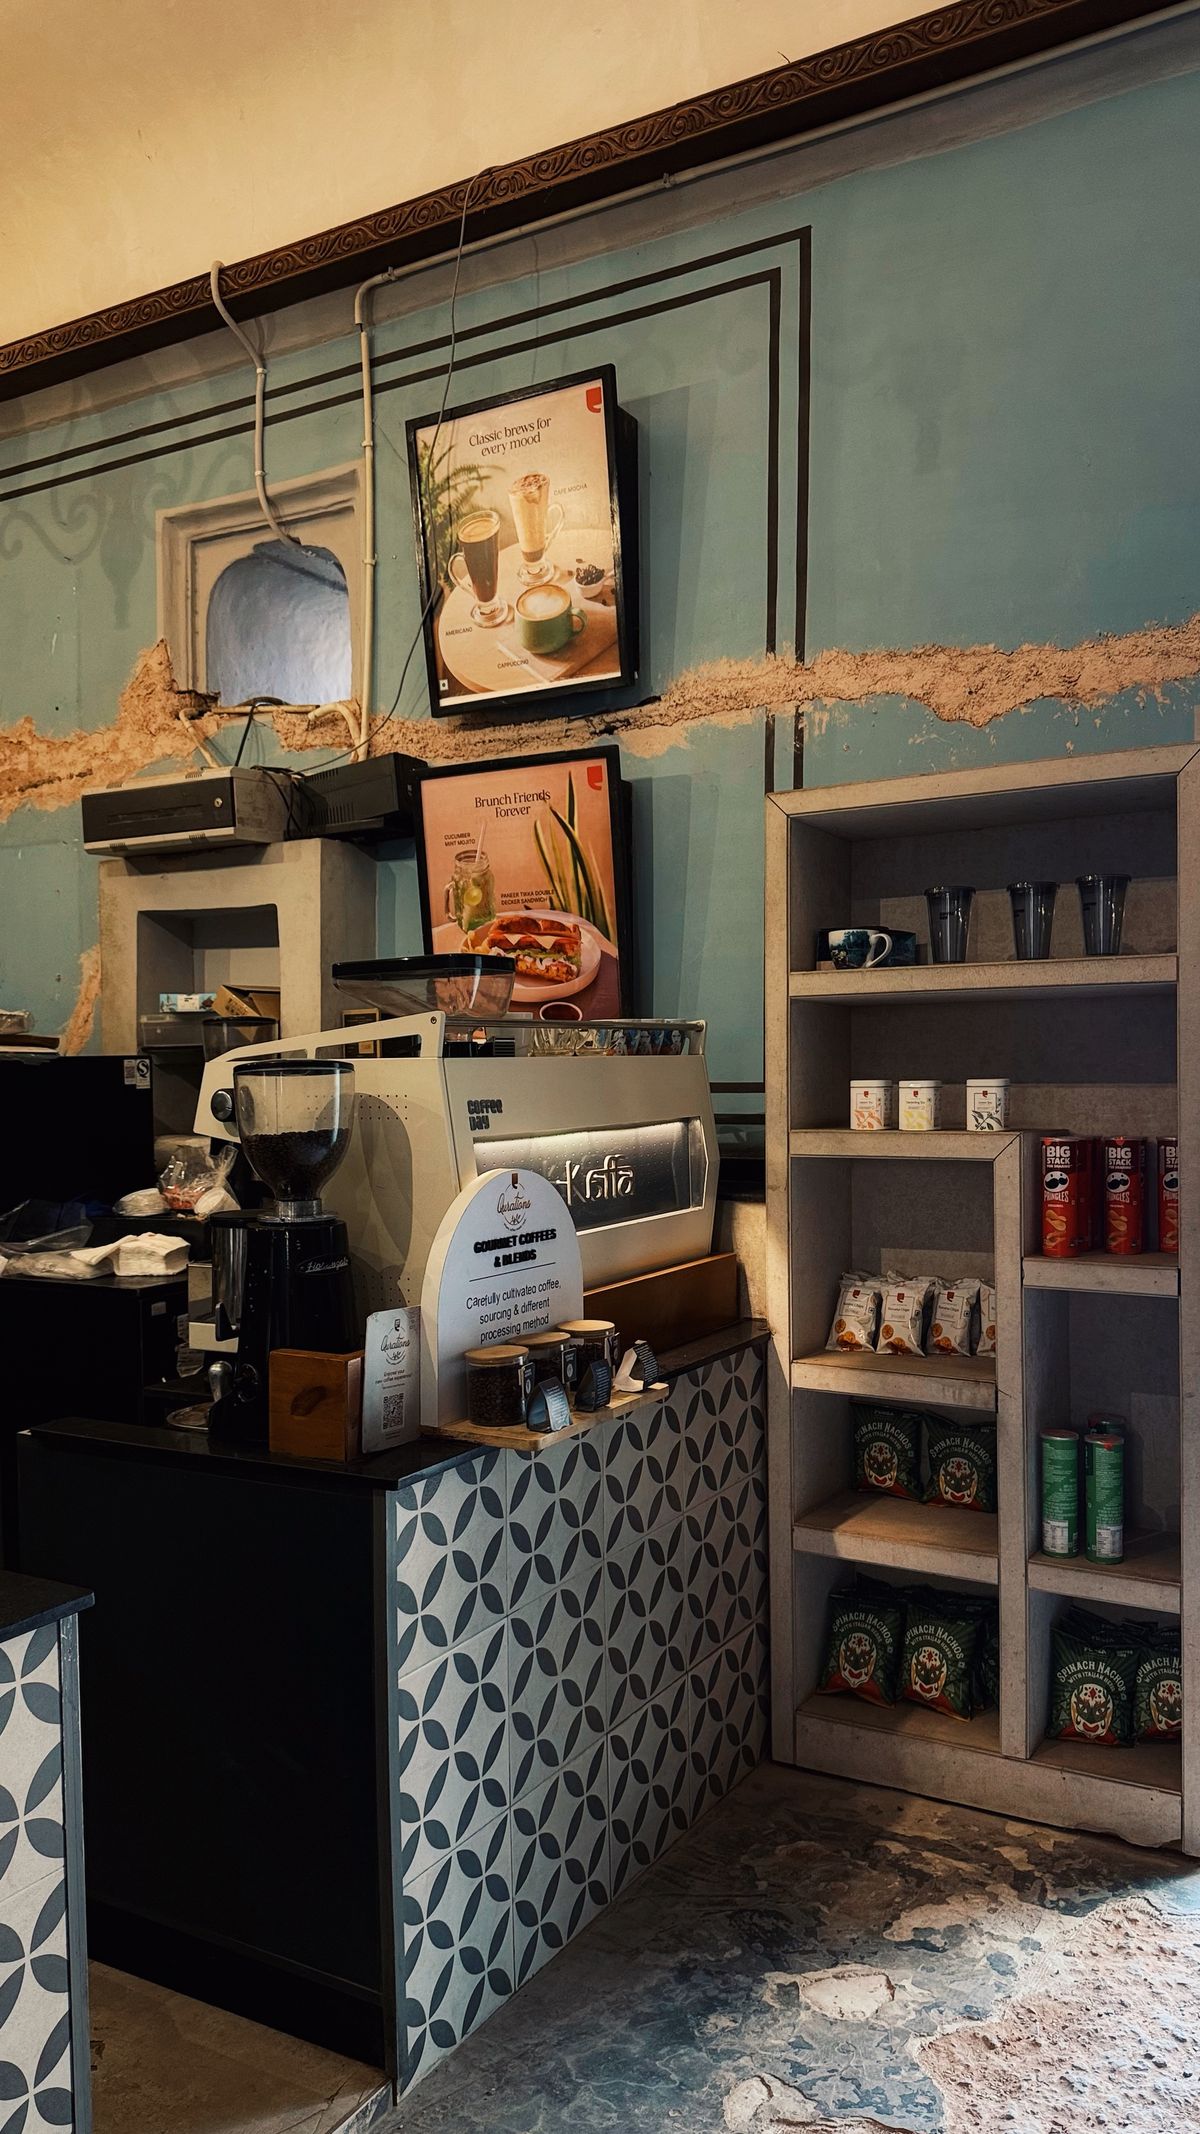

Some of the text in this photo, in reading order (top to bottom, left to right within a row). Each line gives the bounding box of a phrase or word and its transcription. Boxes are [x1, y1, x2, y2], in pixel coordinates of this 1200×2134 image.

[469, 417, 552, 447] Classic brews for
[481, 431, 541, 457] every mood
[445, 627, 473, 636] AMERICANO
[497, 659, 529, 669] CAPPUCCINO
[475, 789, 551, 808] Brunch Friends
[495, 805, 531, 818] Forever
[444, 832, 471, 841] CUCUMBER
[457, 838, 476, 846] MOJITO
[501, 891, 520, 899] PANEER
[535, 888, 555, 896] DOUBLE
[501, 896, 548, 906] DECKER SANDWICH
[1046, 1146, 1071, 1158] BIG
[1108, 1147, 1132, 1159] BIG
[473, 1228, 557, 1254] GOURMET COFFEES
[493, 1249, 537, 1268] & BLENDS
[466, 1279, 561, 1310] Carefully cultivated coffee,
[480, 1297, 550, 1325] sourcing & different
[480, 1313, 549, 1344] processing method
[855, 1422, 912, 1449] SPINACH NACHOS
[929, 1437, 992, 1465] SPINACH NACHOS
[832, 1612, 892, 1644] SPINACH NACHOS
[904, 1624, 964, 1659] SPINACH NACHOS
[1056, 1661, 1127, 1691] SPINACH NACHOS
[1135, 1656, 1171, 1683] SPINACH
